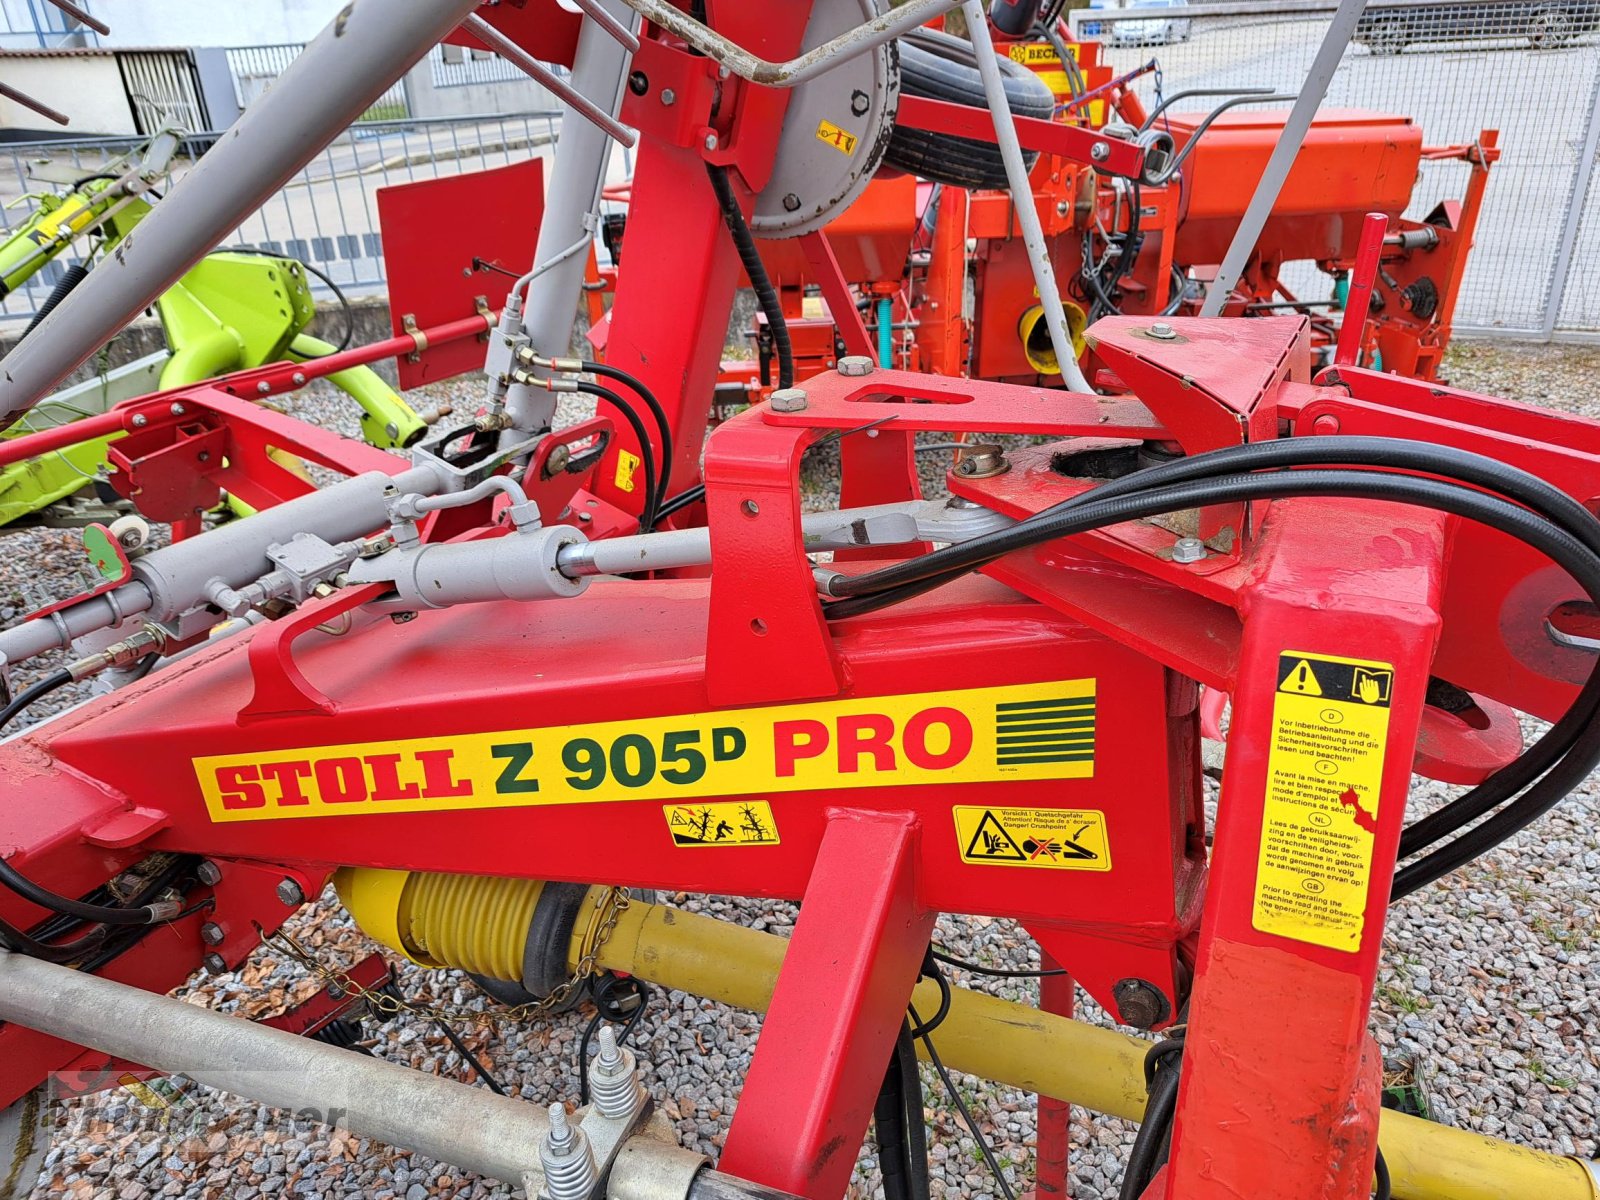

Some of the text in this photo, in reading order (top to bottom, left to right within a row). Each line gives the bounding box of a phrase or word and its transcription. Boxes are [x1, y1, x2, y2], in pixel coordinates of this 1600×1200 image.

[1029, 48, 1075, 59] BECKR
[1280, 727, 1347, 745] Betriebsanleitung
[1296, 721, 1355, 736] Inbetriebnahme
[1278, 736, 1368, 756] Sicherheitsvorschriften
[215, 749, 473, 810] STOLL
[491, 742, 540, 794] Z
[774, 706, 973, 777] PRO
[1317, 751, 1355, 762] beachten!
[1275, 770, 1296, 778] Avant
[1273, 787, 1294, 795] mode
[1296, 790, 1328, 802] d'emploi
[1297, 782, 1313, 790] bien
[1272, 795, 1317, 808] instructions
[1269, 828, 1284, 837] zing
[1309, 836, 1353, 849] veiligheids-
[1270, 819, 1287, 827] Lees
[1301, 825, 1361, 843] gebruiksaanwij-
[1268, 837, 1317, 851] voorschriften
[1320, 846, 1340, 856] door,
[1266, 853, 1288, 861] wordt
[1290, 858, 1324, 869] genomen
[1338, 867, 1355, 877] volg
[1292, 850, 1324, 860] machine
[1335, 859, 1364, 869] gebruik
[1276, 864, 1325, 877] aanwijzingen
[1327, 874, 1348, 883] ervan
[1262, 893, 1293, 905] machine
[1263, 884, 1280, 893] Prior
[1292, 892, 1327, 905] operating
